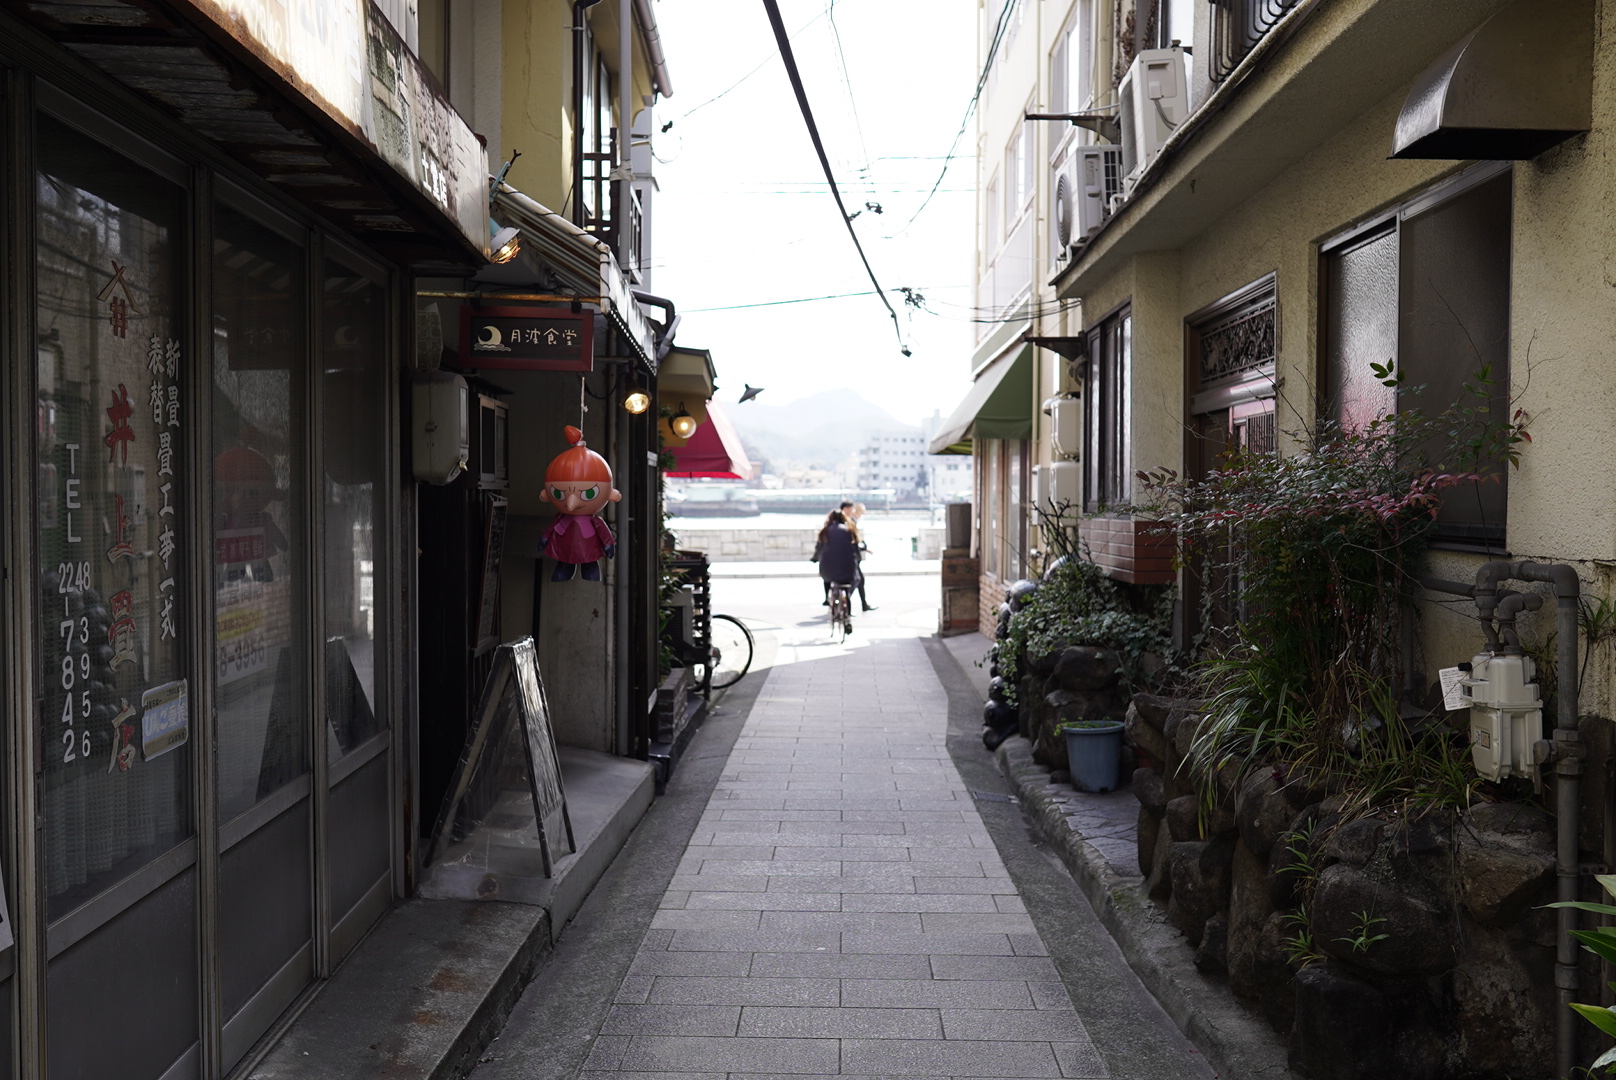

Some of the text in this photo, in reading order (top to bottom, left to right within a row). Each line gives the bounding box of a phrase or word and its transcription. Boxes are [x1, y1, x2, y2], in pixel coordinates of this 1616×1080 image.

[510, 327, 577, 346] 月波食堂
[65, 443, 81, 543] TEL
[105, 382, 138, 774] 井上畳店
